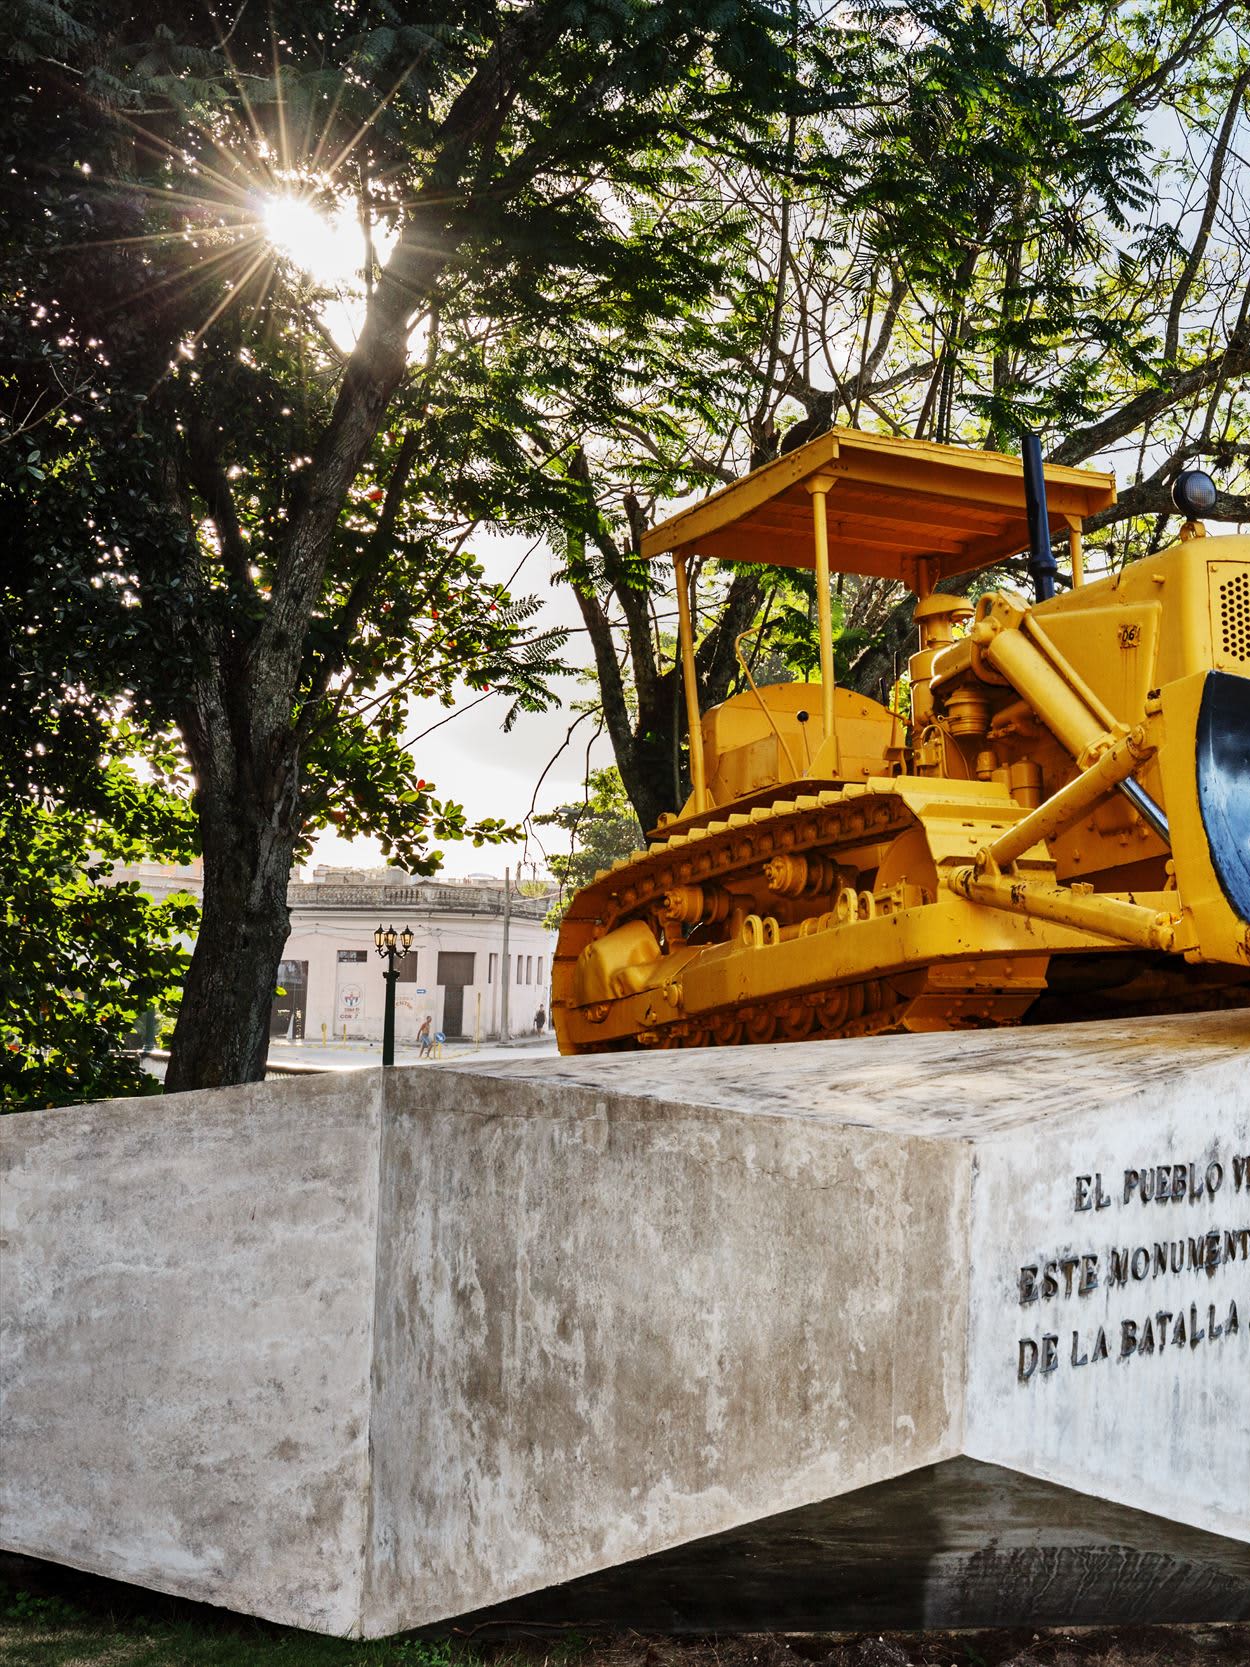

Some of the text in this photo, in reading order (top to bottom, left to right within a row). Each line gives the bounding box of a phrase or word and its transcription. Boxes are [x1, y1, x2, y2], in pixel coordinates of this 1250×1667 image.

[1074, 1173, 1111, 1212] EL
[1123, 1160, 1223, 1206] PUEBLO
[1018, 1254, 1098, 1304] ESTE
[1018, 1333, 1058, 1381] DE
[1071, 1326, 1108, 1366] LA
[1120, 1300, 1239, 1357] BATALLA
